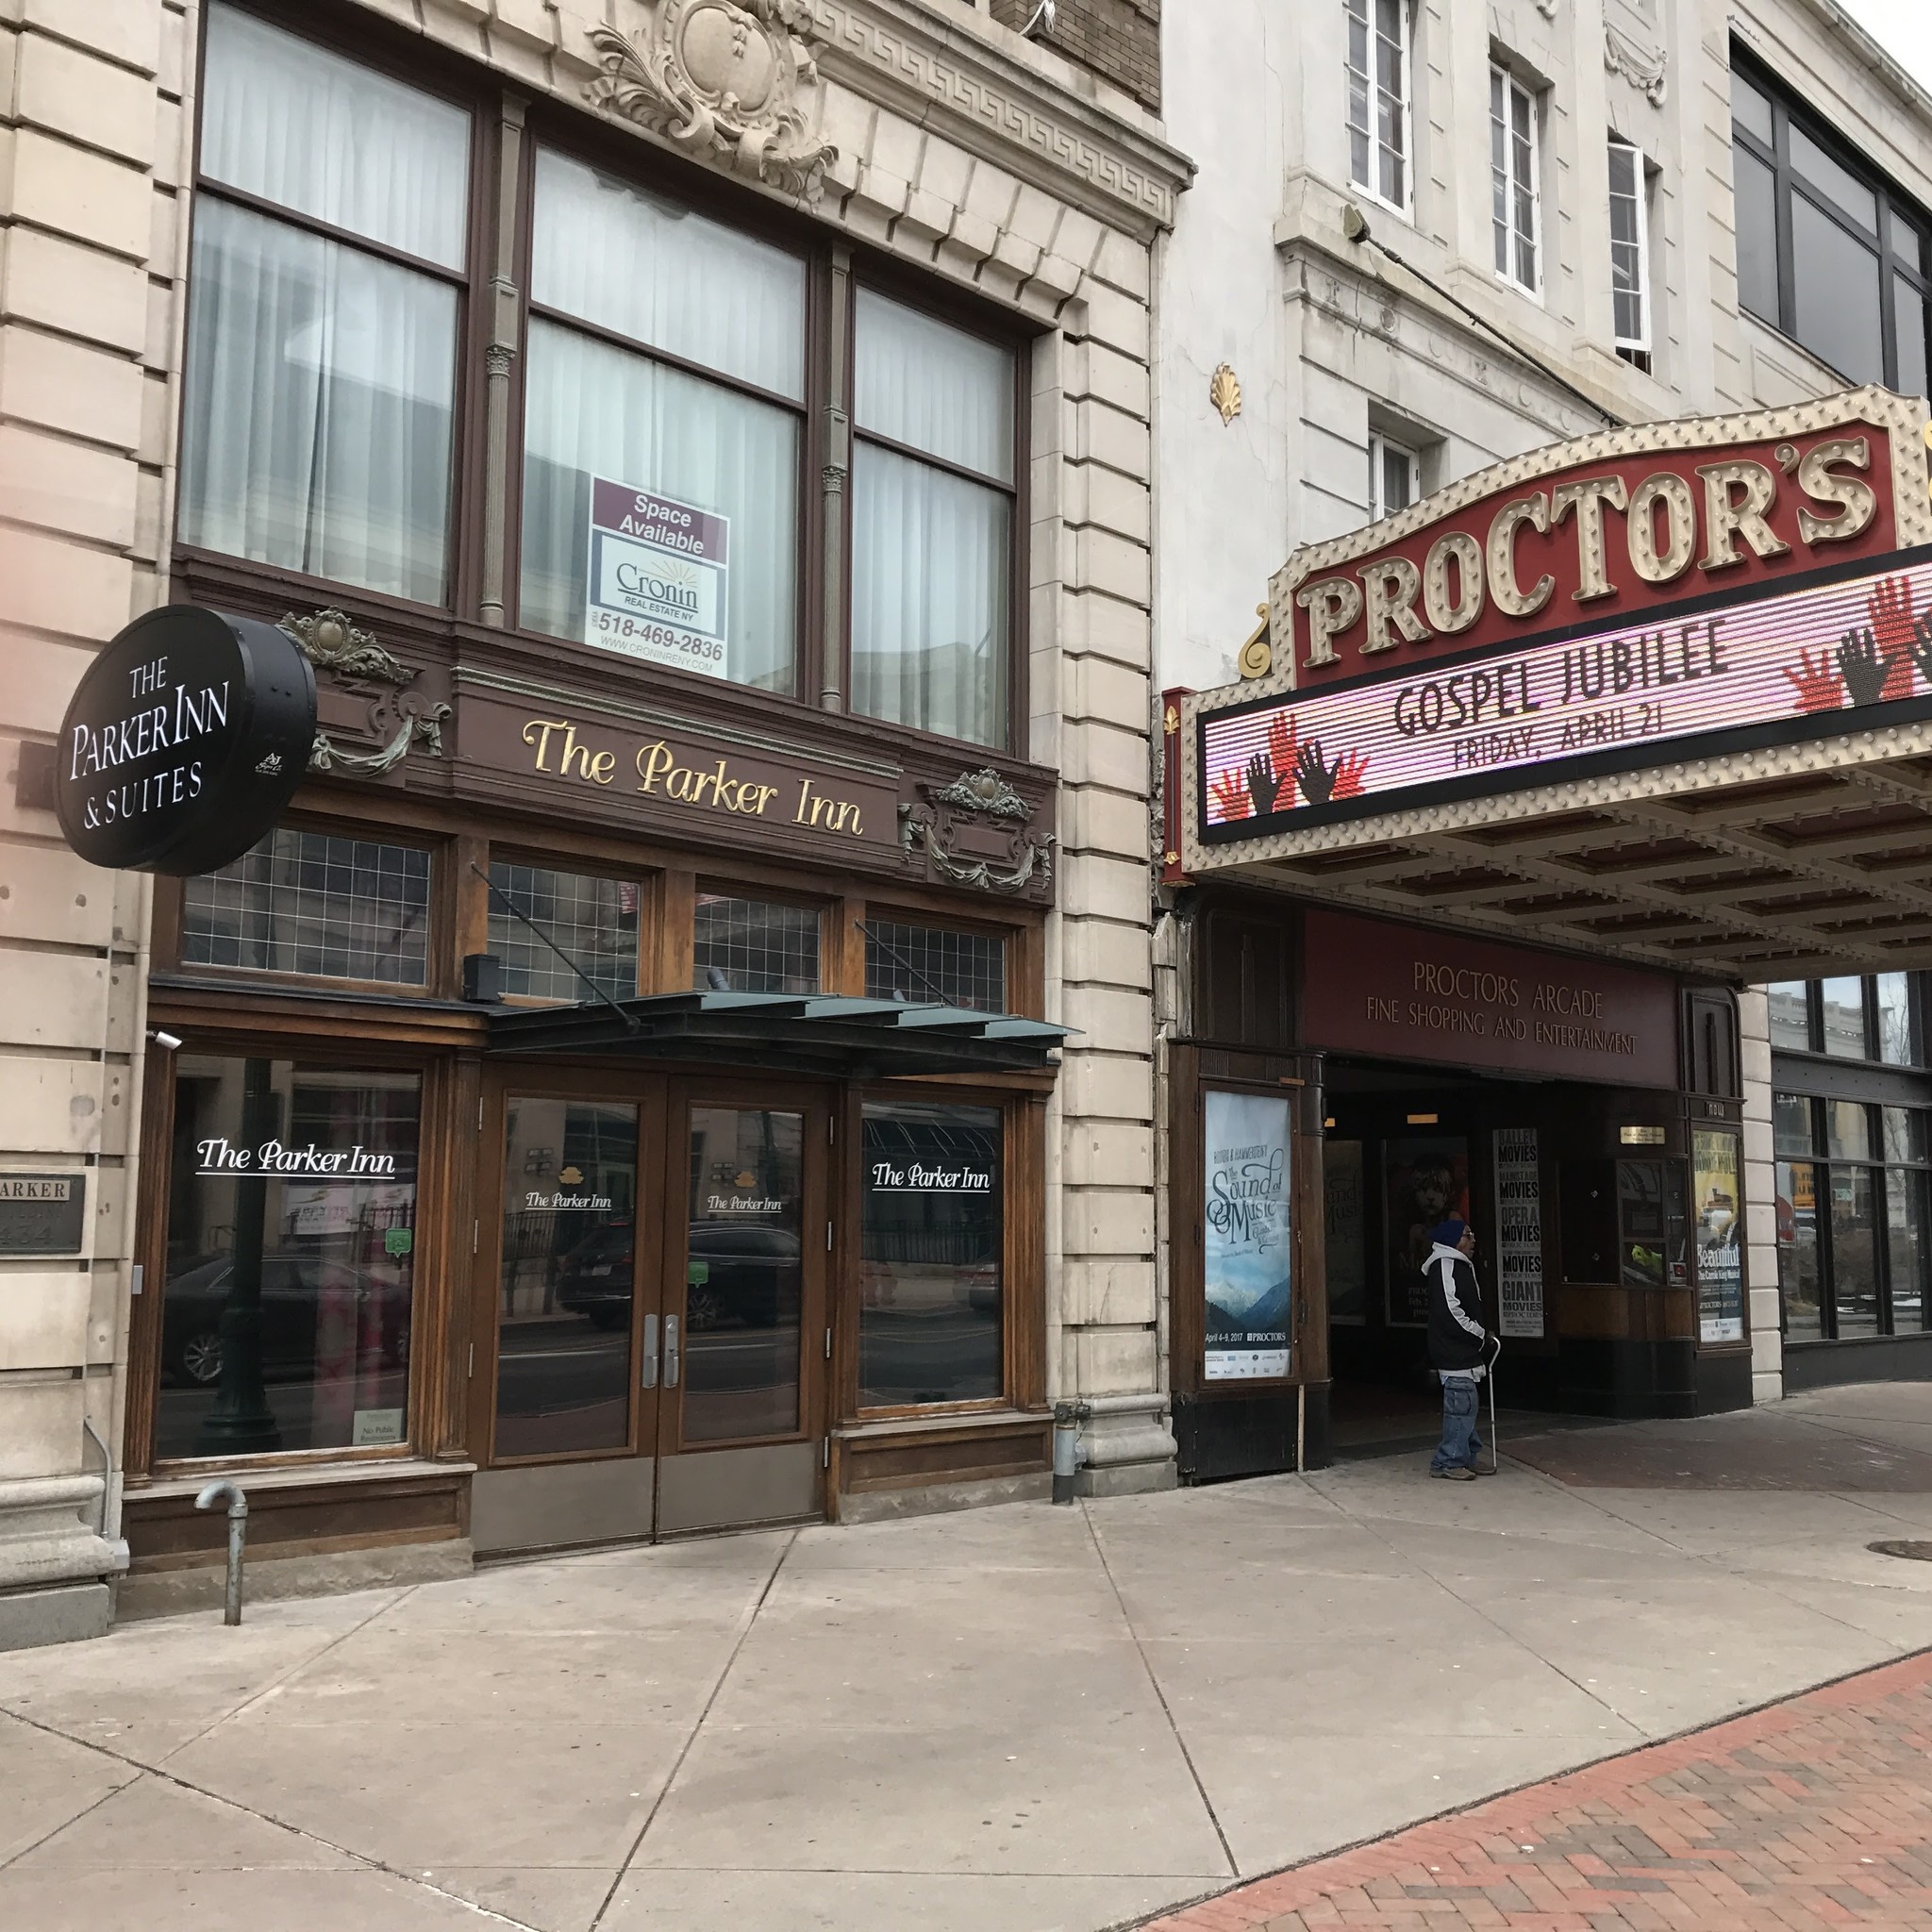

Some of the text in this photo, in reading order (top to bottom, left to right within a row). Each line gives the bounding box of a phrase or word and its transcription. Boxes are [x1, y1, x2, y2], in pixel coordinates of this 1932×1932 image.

[634, 494, 691, 527] Space
[619, 514, 704, 555] Available
[1296, 436, 1877, 669] PROCTOR'S
[617, 563, 698, 608] Cronin
[625, 596, 693, 623] REAL ESTATE NY
[599, 612, 723, 661] 518-469-2836
[129, 656, 168, 698] THE
[1394, 620, 1726, 737] GOSPEL JUBILEE
[69, 680, 230, 781] PARKER INN
[1453, 701, 1663, 771] FRIDAY, APRIL 21
[523, 720, 863, 836] The Parker Inn
[84, 761, 202, 829] & SUITES
[1415, 961, 1603, 1019] PROCTORS ARCADE
[1367, 996, 1638, 1056] FINE SHOPPING AND ENTERTAINMENT
[196, 1138, 395, 1174] The Parker Inn
[1498, 1145, 1537, 1162] MOVIES
[0, 1182, 65, 1198] ARKER
[872, 1161, 991, 1189] The Parker Inn
[1500, 1182, 1538, 1198] MOVIES
[525, 1191, 611, 1208] The Parker Inn
[708, 1195, 781, 1210] The Parker Inn
[1229, 1196, 1276, 1244] Music
[1502, 1207, 1539, 1224] OPERA
[1502, 1225, 1540, 1241] MOVIES
[1503, 1256, 1541, 1273] MOVIES
[1697, 1243, 1740, 1267] Beautiful
[1502, 1281, 1542, 1301] GIANT
[1503, 1302, 1542, 1311] MOVIES
[1205, 1333, 1217, 1343] April
[1231, 1333, 1242, 1341] 2017
[1253, 1333, 1286, 1341] PROCTORS
